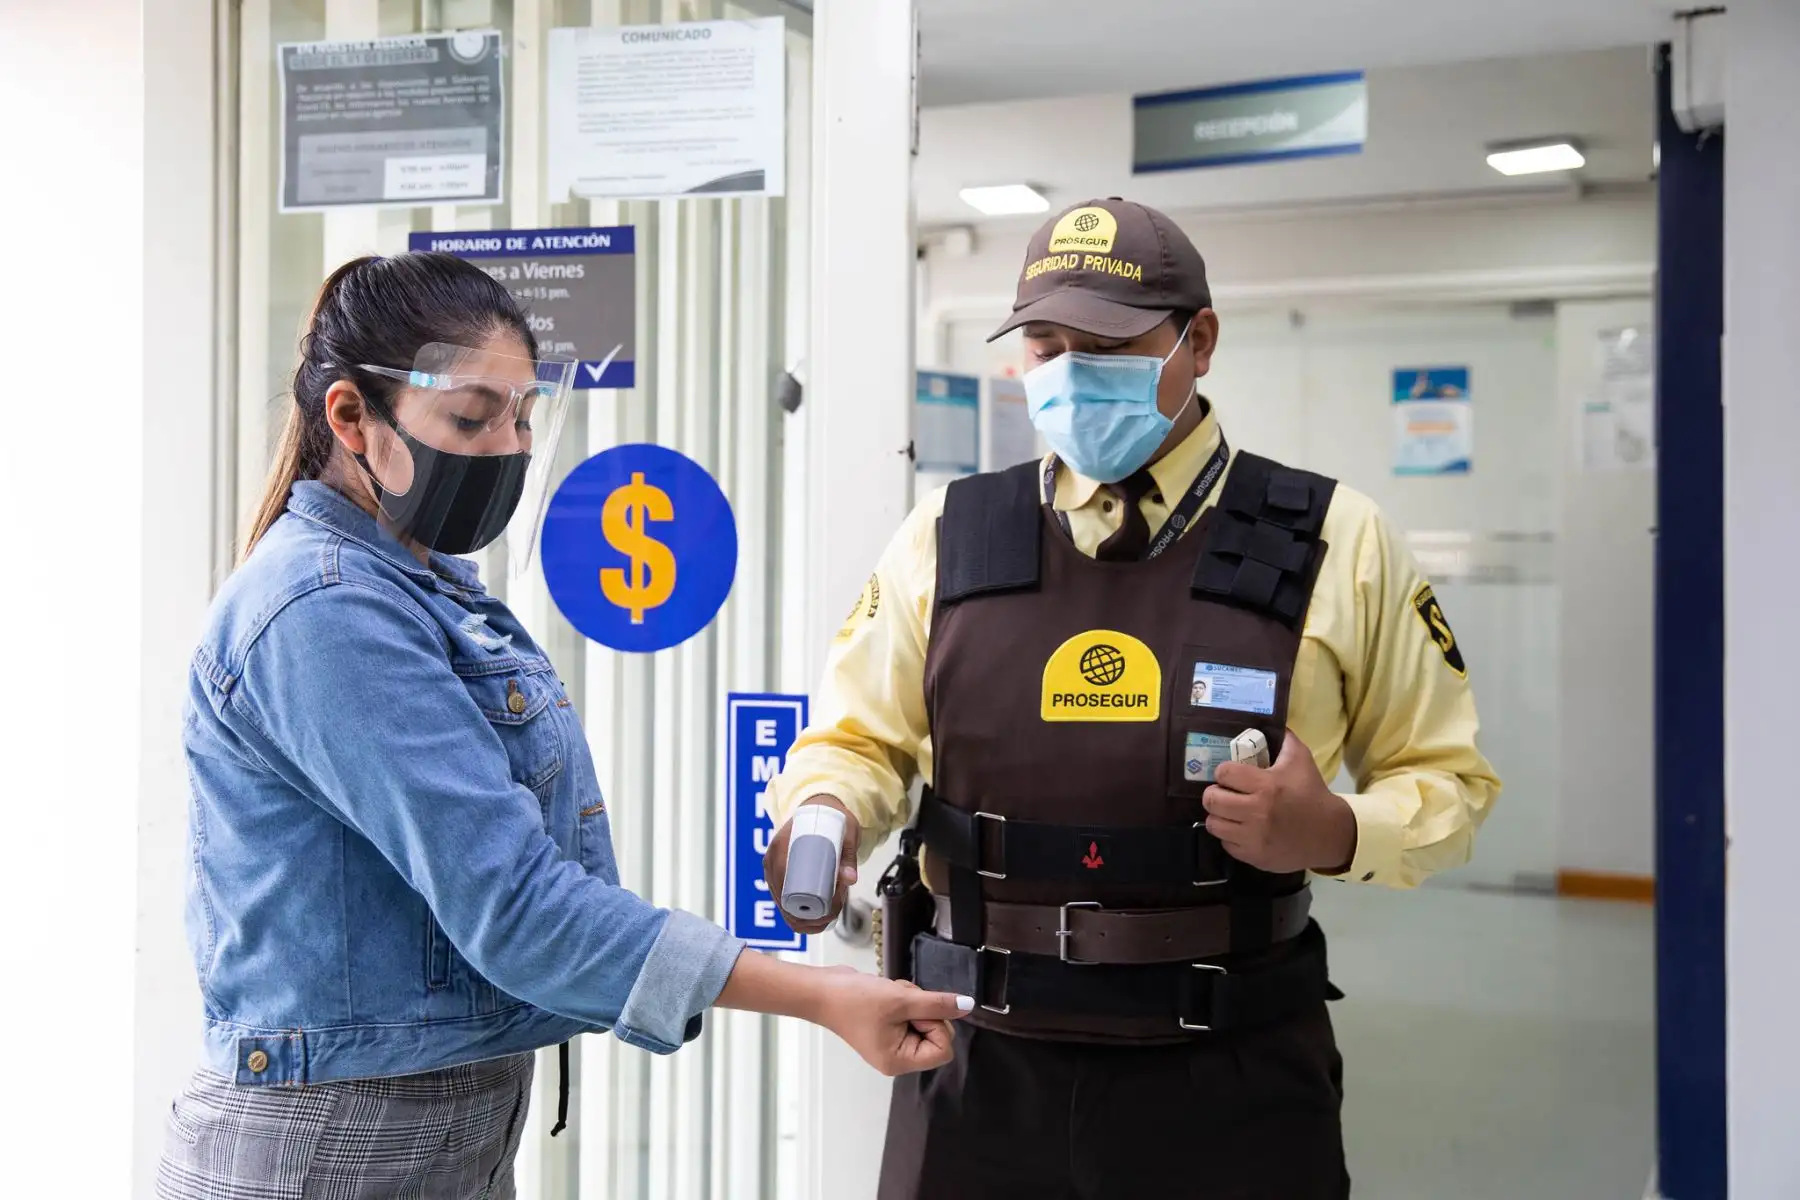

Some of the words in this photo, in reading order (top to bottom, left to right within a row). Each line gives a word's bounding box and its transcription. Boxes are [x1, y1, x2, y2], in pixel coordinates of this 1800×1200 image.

[621, 28, 712, 44] COMUNICADO
[431, 239, 501, 252] HORARIO
[506, 237, 527, 250] DE
[532, 232, 611, 249] ATENCIÓN
[1054, 237, 1108, 247] PROSEGUR
[522, 261, 585, 280] Viernes
[1025, 253, 1079, 281] SEGURIDAD
[1083, 254, 1142, 282] PRIVADA
[1193, 457, 1223, 497] PROSEGUR
[600, 472, 676, 624] $
[1148, 529, 1175, 559] PROSE
[1052, 693, 1149, 708] PROSEGUR
